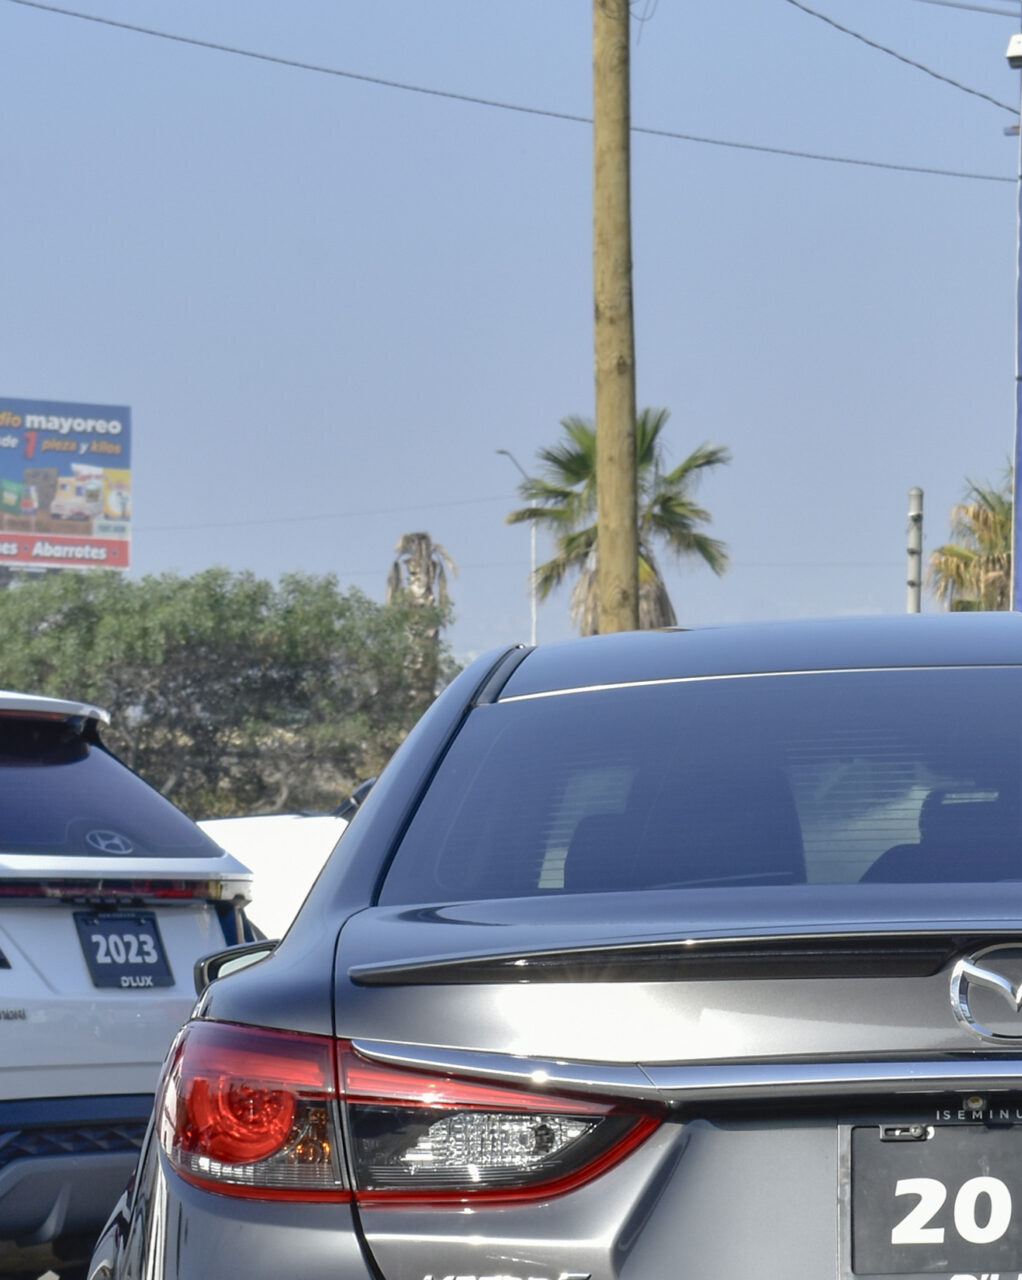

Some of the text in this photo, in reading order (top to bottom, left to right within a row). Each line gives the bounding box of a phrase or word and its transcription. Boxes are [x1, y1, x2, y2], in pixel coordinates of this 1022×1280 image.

[25, 414, 122, 434] mayoreo
[24, 431, 38, 459] 1
[79, 442, 89, 455] y
[32, 541, 107, 560] Abarrotes
[91, 934, 159, 964] 2023
